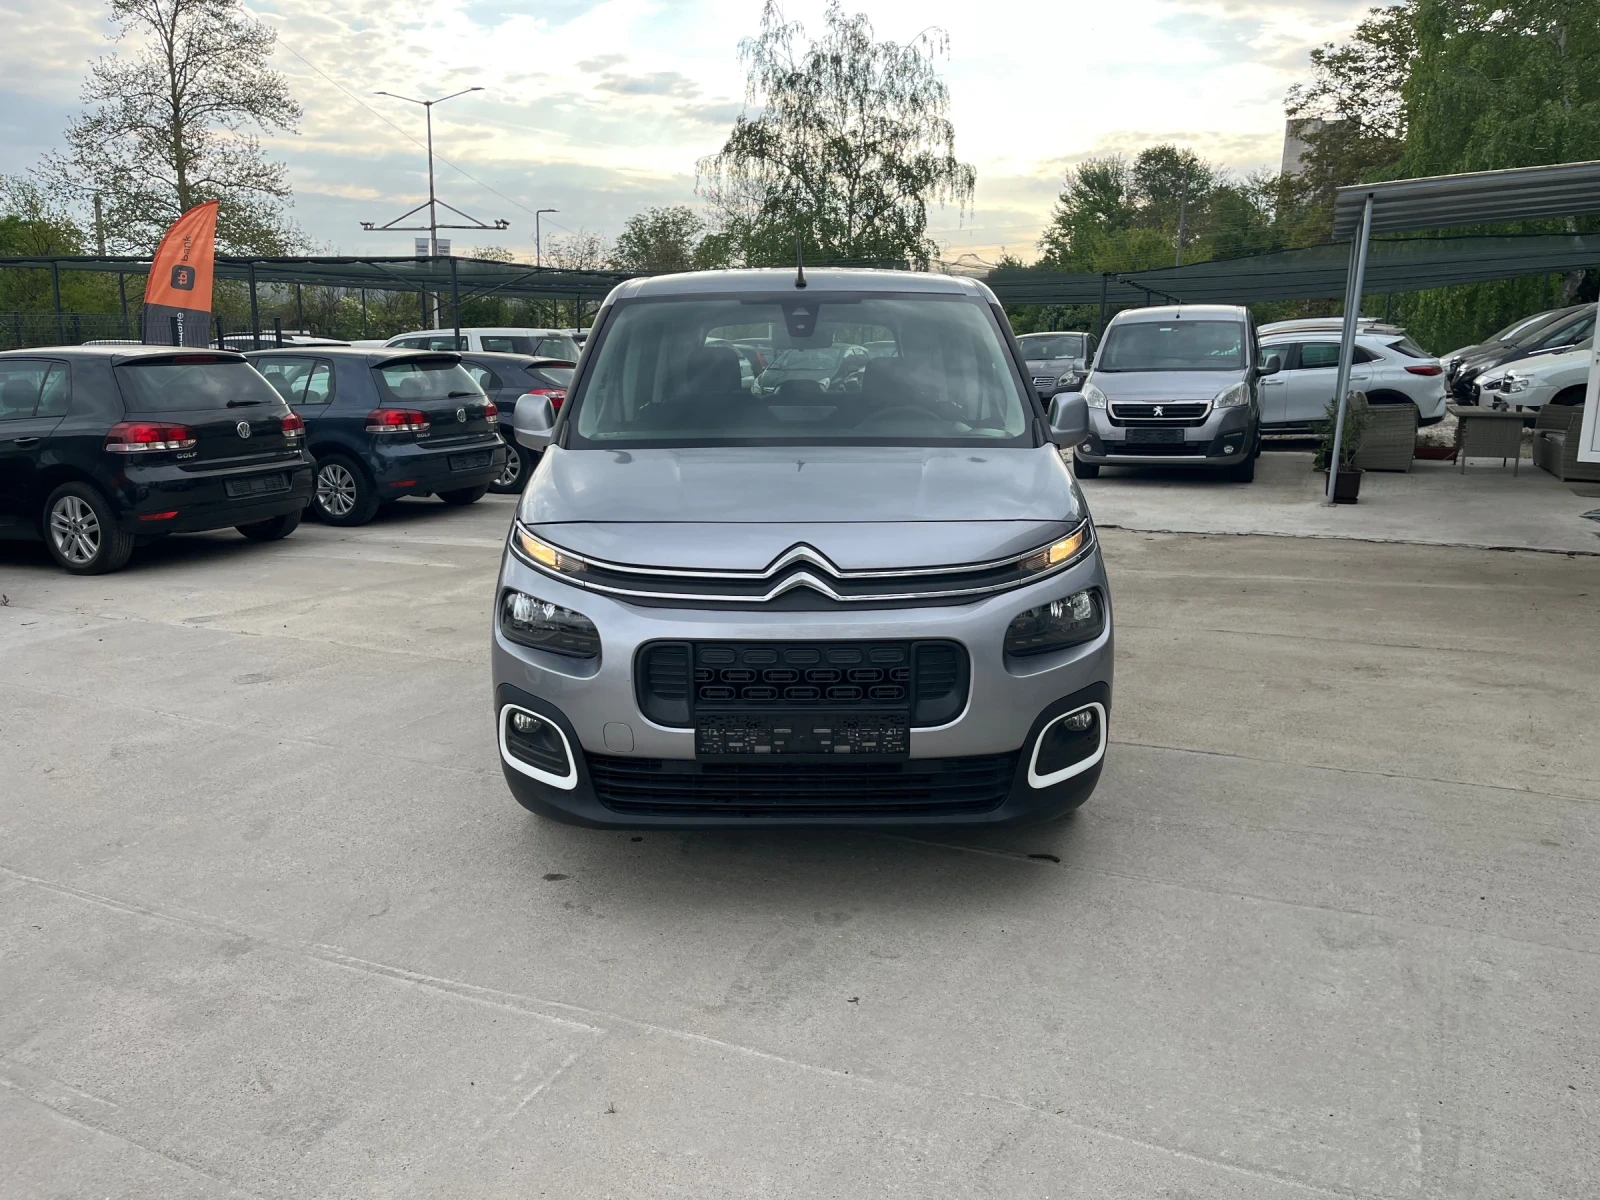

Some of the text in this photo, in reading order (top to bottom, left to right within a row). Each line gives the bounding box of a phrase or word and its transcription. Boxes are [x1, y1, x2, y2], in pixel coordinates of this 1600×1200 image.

[177, 235, 192, 285] tbi bank
[176, 451, 198, 459] GOLF
